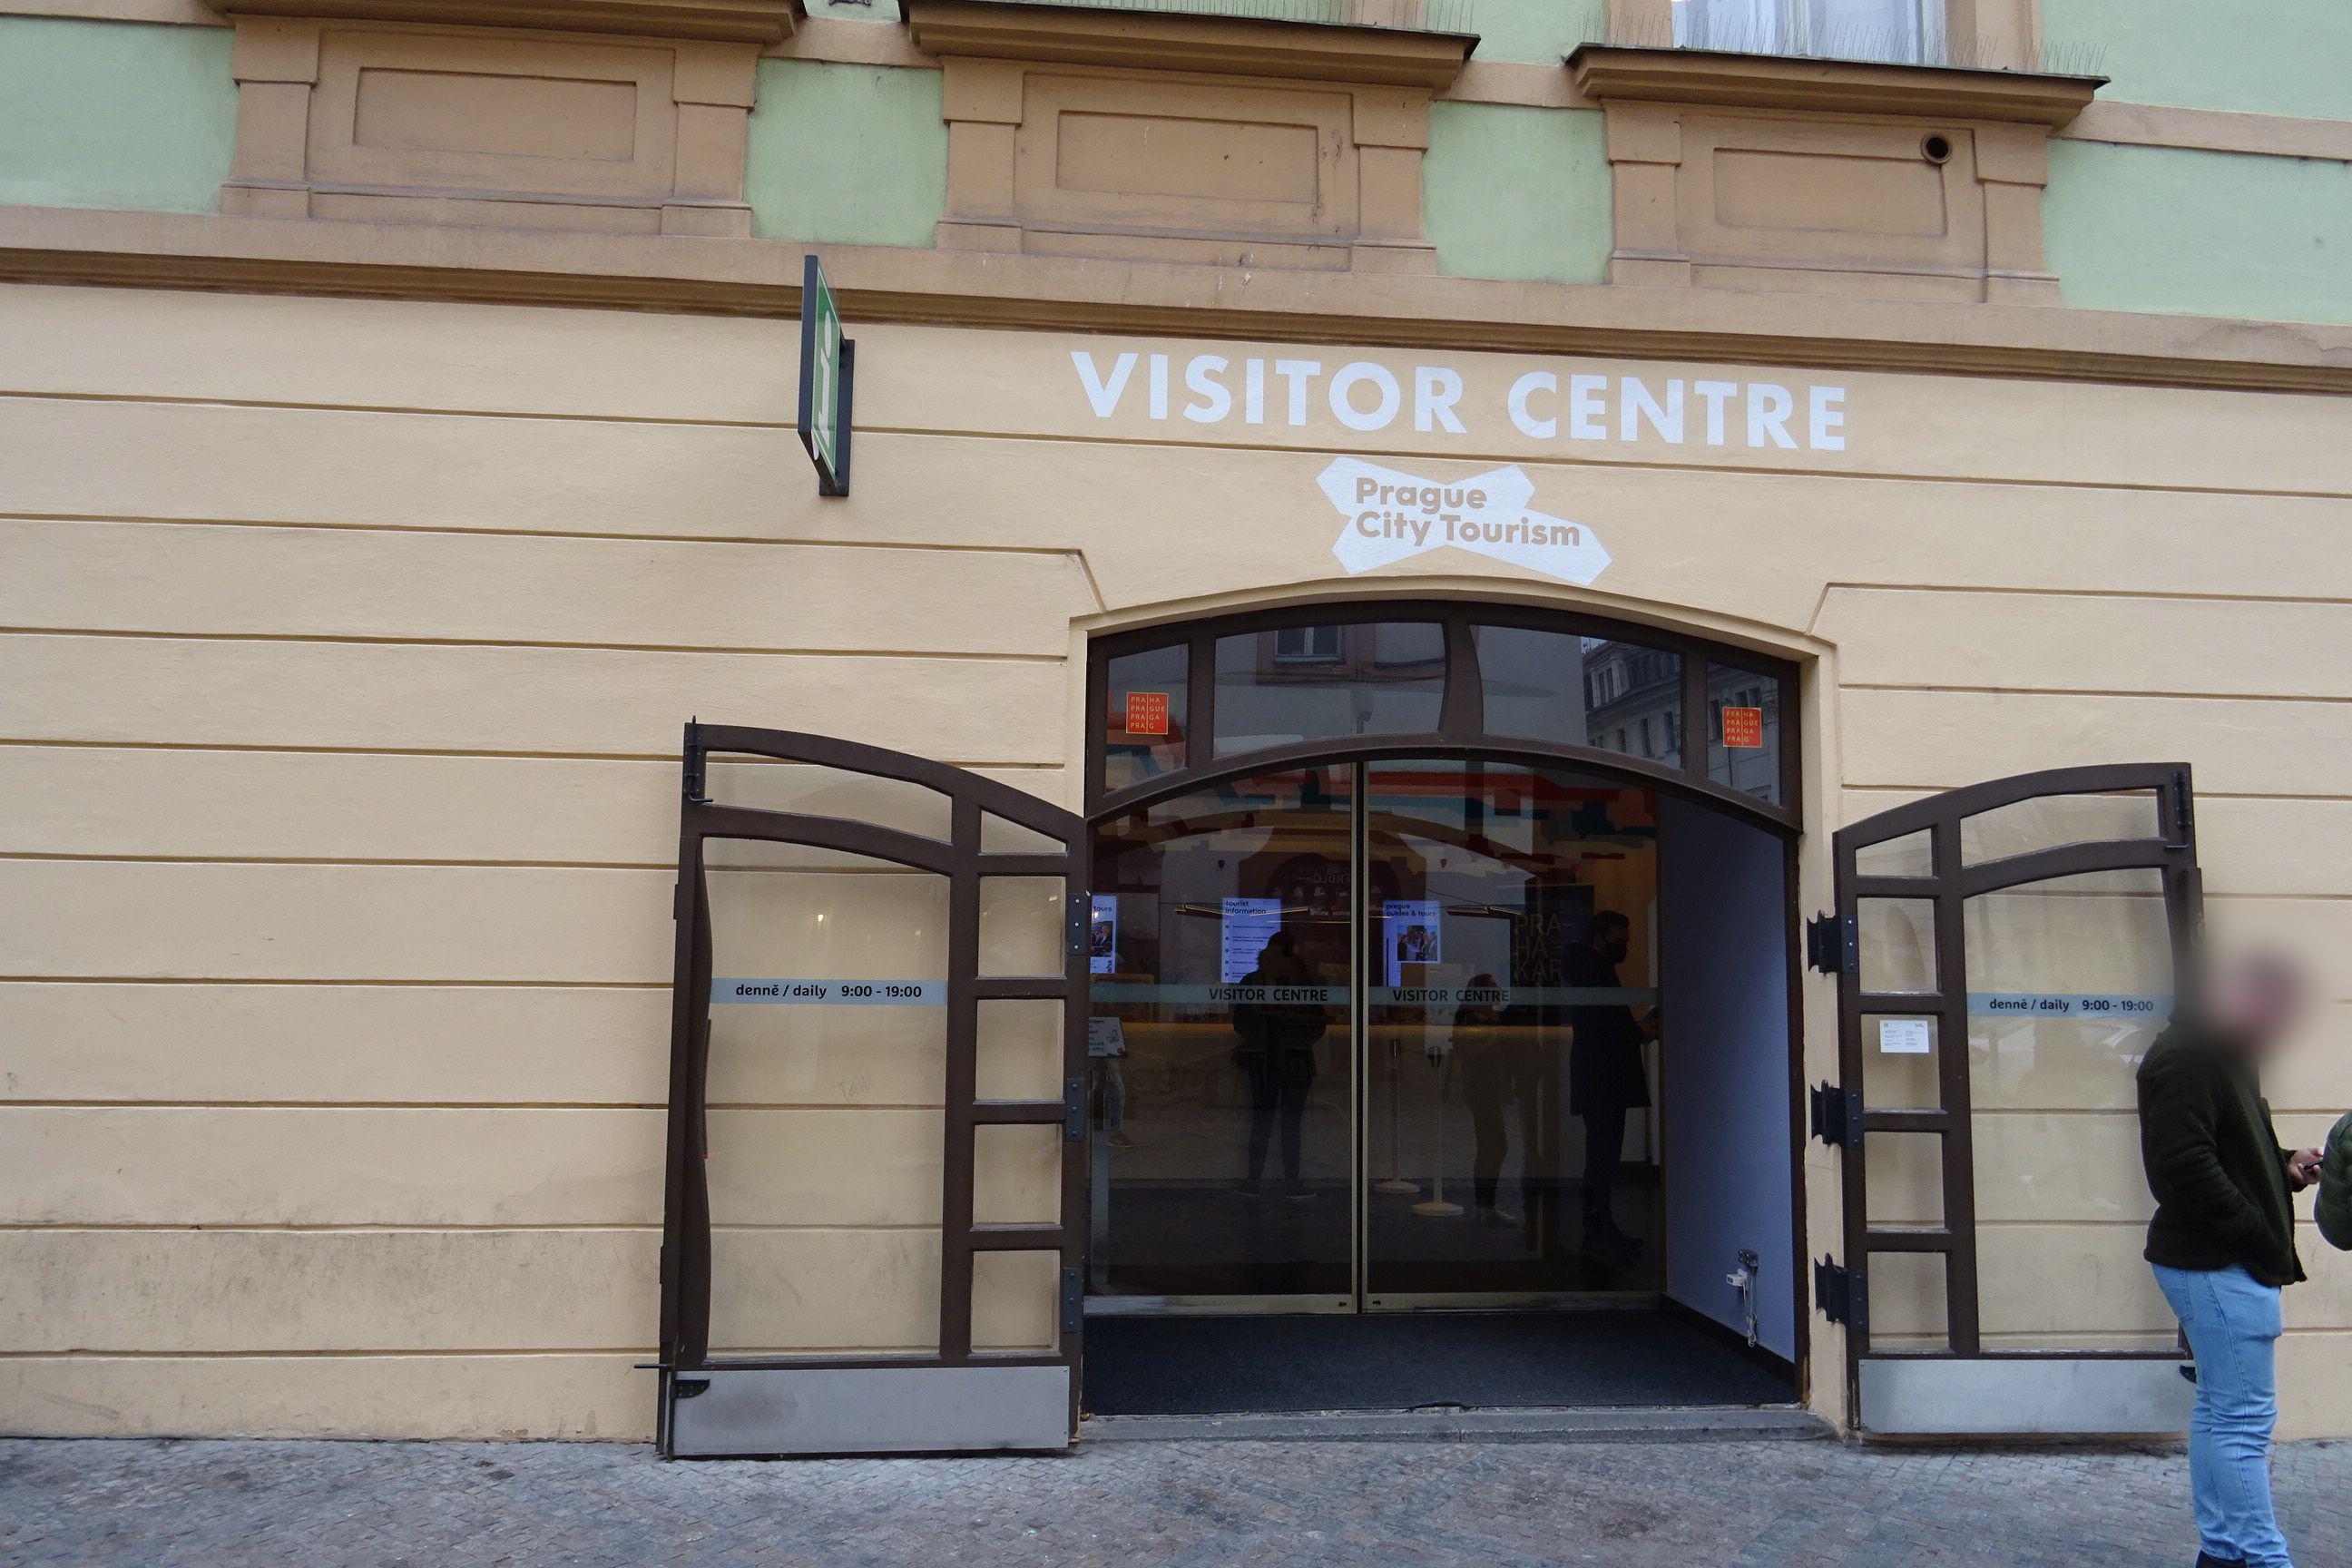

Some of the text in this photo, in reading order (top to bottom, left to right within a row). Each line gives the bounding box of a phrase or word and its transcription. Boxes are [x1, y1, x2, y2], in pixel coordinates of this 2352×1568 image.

[1071, 350, 1846, 452] VISITOR CENTRE
[1356, 477, 1487, 514] Prague
[1356, 511, 1580, 546] City Tourism
[736, 984, 779, 996] denně
[793, 985, 827, 999] daily
[841, 985, 872, 997] 9:00
[885, 985, 922, 997] 19:00
[1209, 988, 1328, 1002] VISITOR CENTRE
[1393, 990, 1509, 1002] VISITOR CENTRE
[1989, 998, 2027, 1010] denně
[2040, 999, 2070, 1012] daily
[2082, 999, 2110, 1011] 9:00
[2122, 1000, 2153, 1011] 19:00
